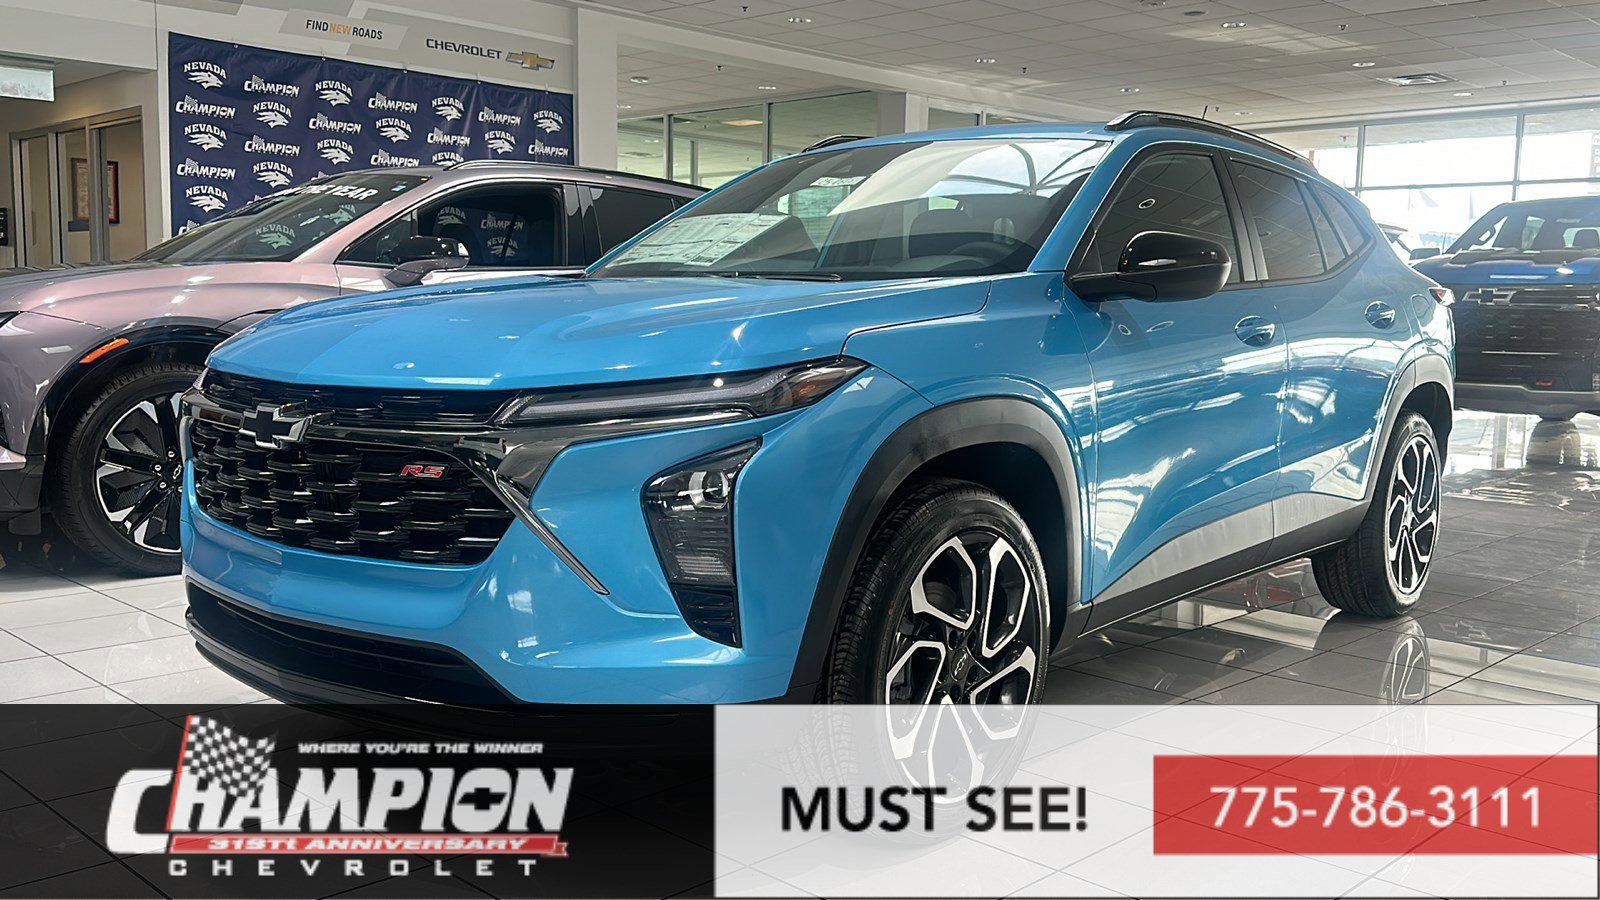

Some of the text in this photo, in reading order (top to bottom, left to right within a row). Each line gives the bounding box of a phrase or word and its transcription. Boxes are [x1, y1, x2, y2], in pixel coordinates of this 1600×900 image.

[306, 20, 383, 40] FIND NEW ROADS
[426, 38, 502, 60] CHEVROLET
[183, 61, 227, 79] NEVADA
[244, 80, 300, 97] CHAMPION
[315, 80, 353, 97] NEVADA
[175, 101, 236, 117] CHAMPION
[253, 101, 292, 118] NEVADA
[368, 98, 418, 112] CHAMPION
[432, 97, 465, 111] NEVADA
[478, 111, 521, 125] CHAMPION
[533, 110, 563, 124] NEVADA
[184, 123, 227, 140] NEVADA
[309, 118, 362, 133] CHAMPION
[375, 117, 412, 133] NEVADA
[427, 133, 471, 146] CHAMPION
[485, 131, 516, 145] NEVADA
[244, 140, 300, 155] CHAMPION
[317, 139, 354, 155] NEVADA
[528, 145, 568, 157] CHAMPION
[370, 154, 419, 167] CHAMPION
[432, 151, 464, 163] NEVADA
[176, 163, 236, 179] CHAMPION
[253, 161, 294, 177] NEVADA
[185, 185, 229, 201] NEVADA
[325, 185, 378, 200] YEAR
[255, 224, 295, 238] NEVADA
[481, 219, 524, 231] CHAMPON
[401, 464, 446, 478] RS
